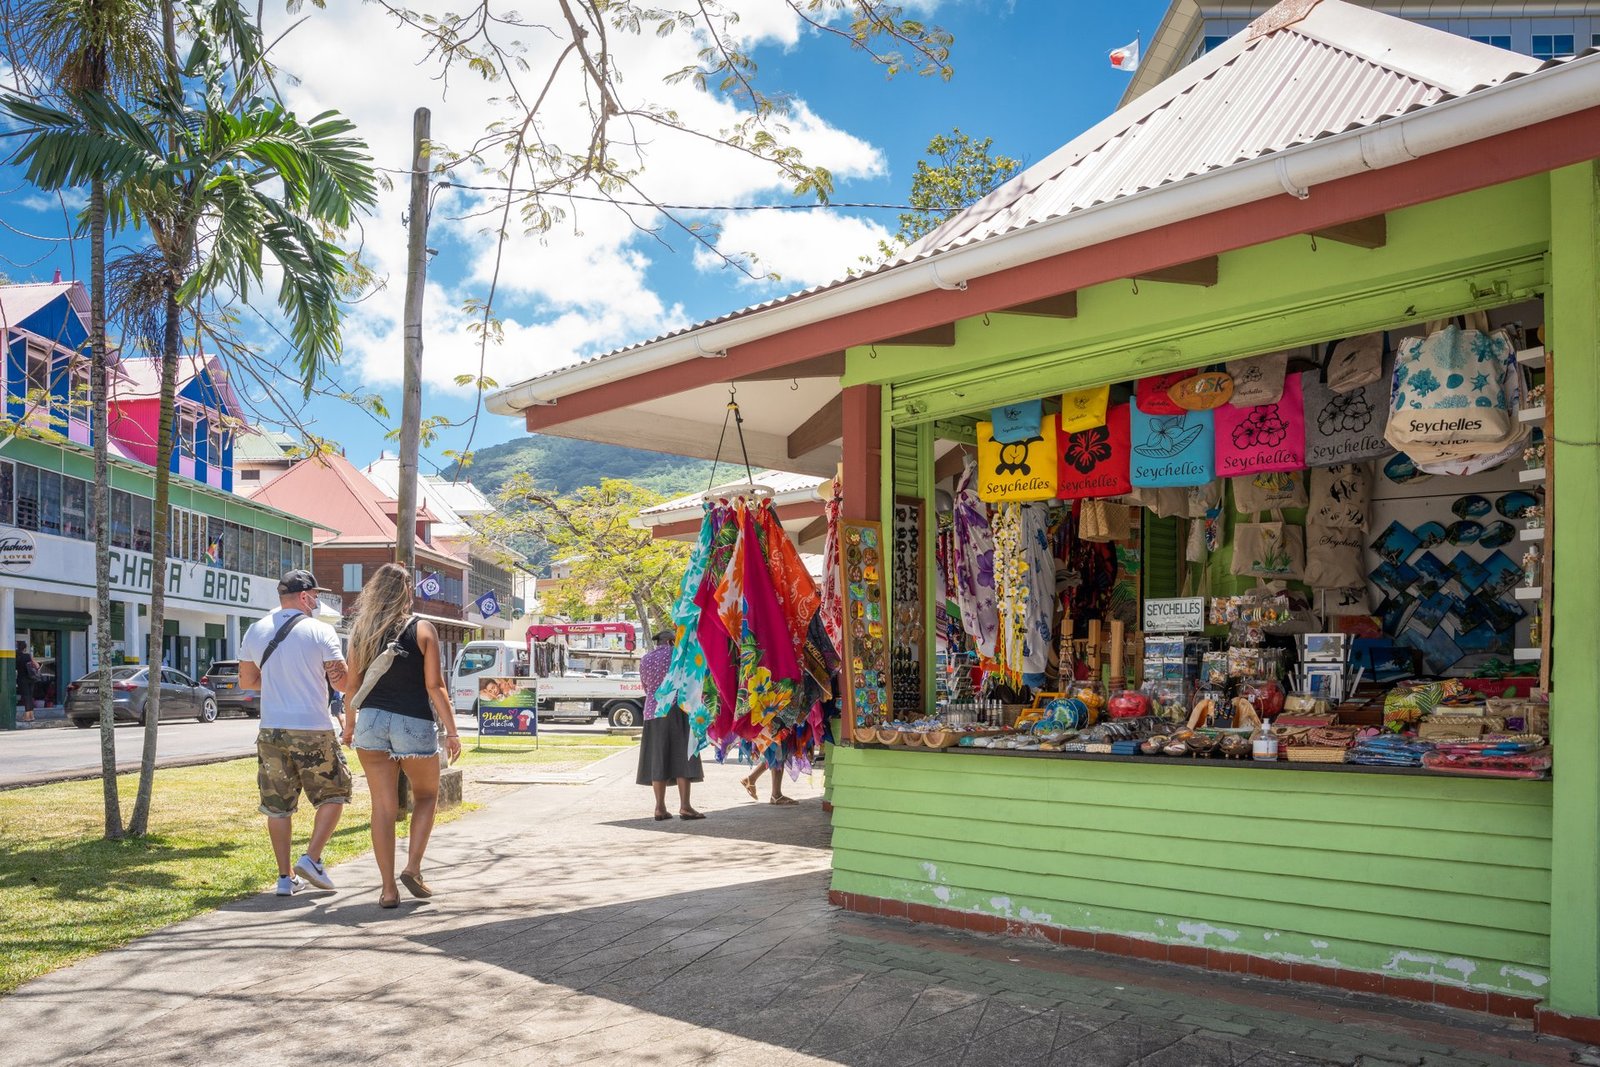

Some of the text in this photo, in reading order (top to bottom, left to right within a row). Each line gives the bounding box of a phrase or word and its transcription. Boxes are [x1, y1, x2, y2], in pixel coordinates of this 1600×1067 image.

[1409, 418, 1482, 434] Seychelles
[1313, 436, 1386, 459] Seychelles
[1224, 450, 1297, 470] Seychelles
[1135, 462, 1204, 480] Seychelles
[986, 477, 1050, 496] Seychelles
[1060, 474, 1117, 491] Seychelles
[109, 551, 182, 593] CHAA
[1147, 602, 1200, 616] SEYCHELLES
[483, 719, 515, 728] Collection
